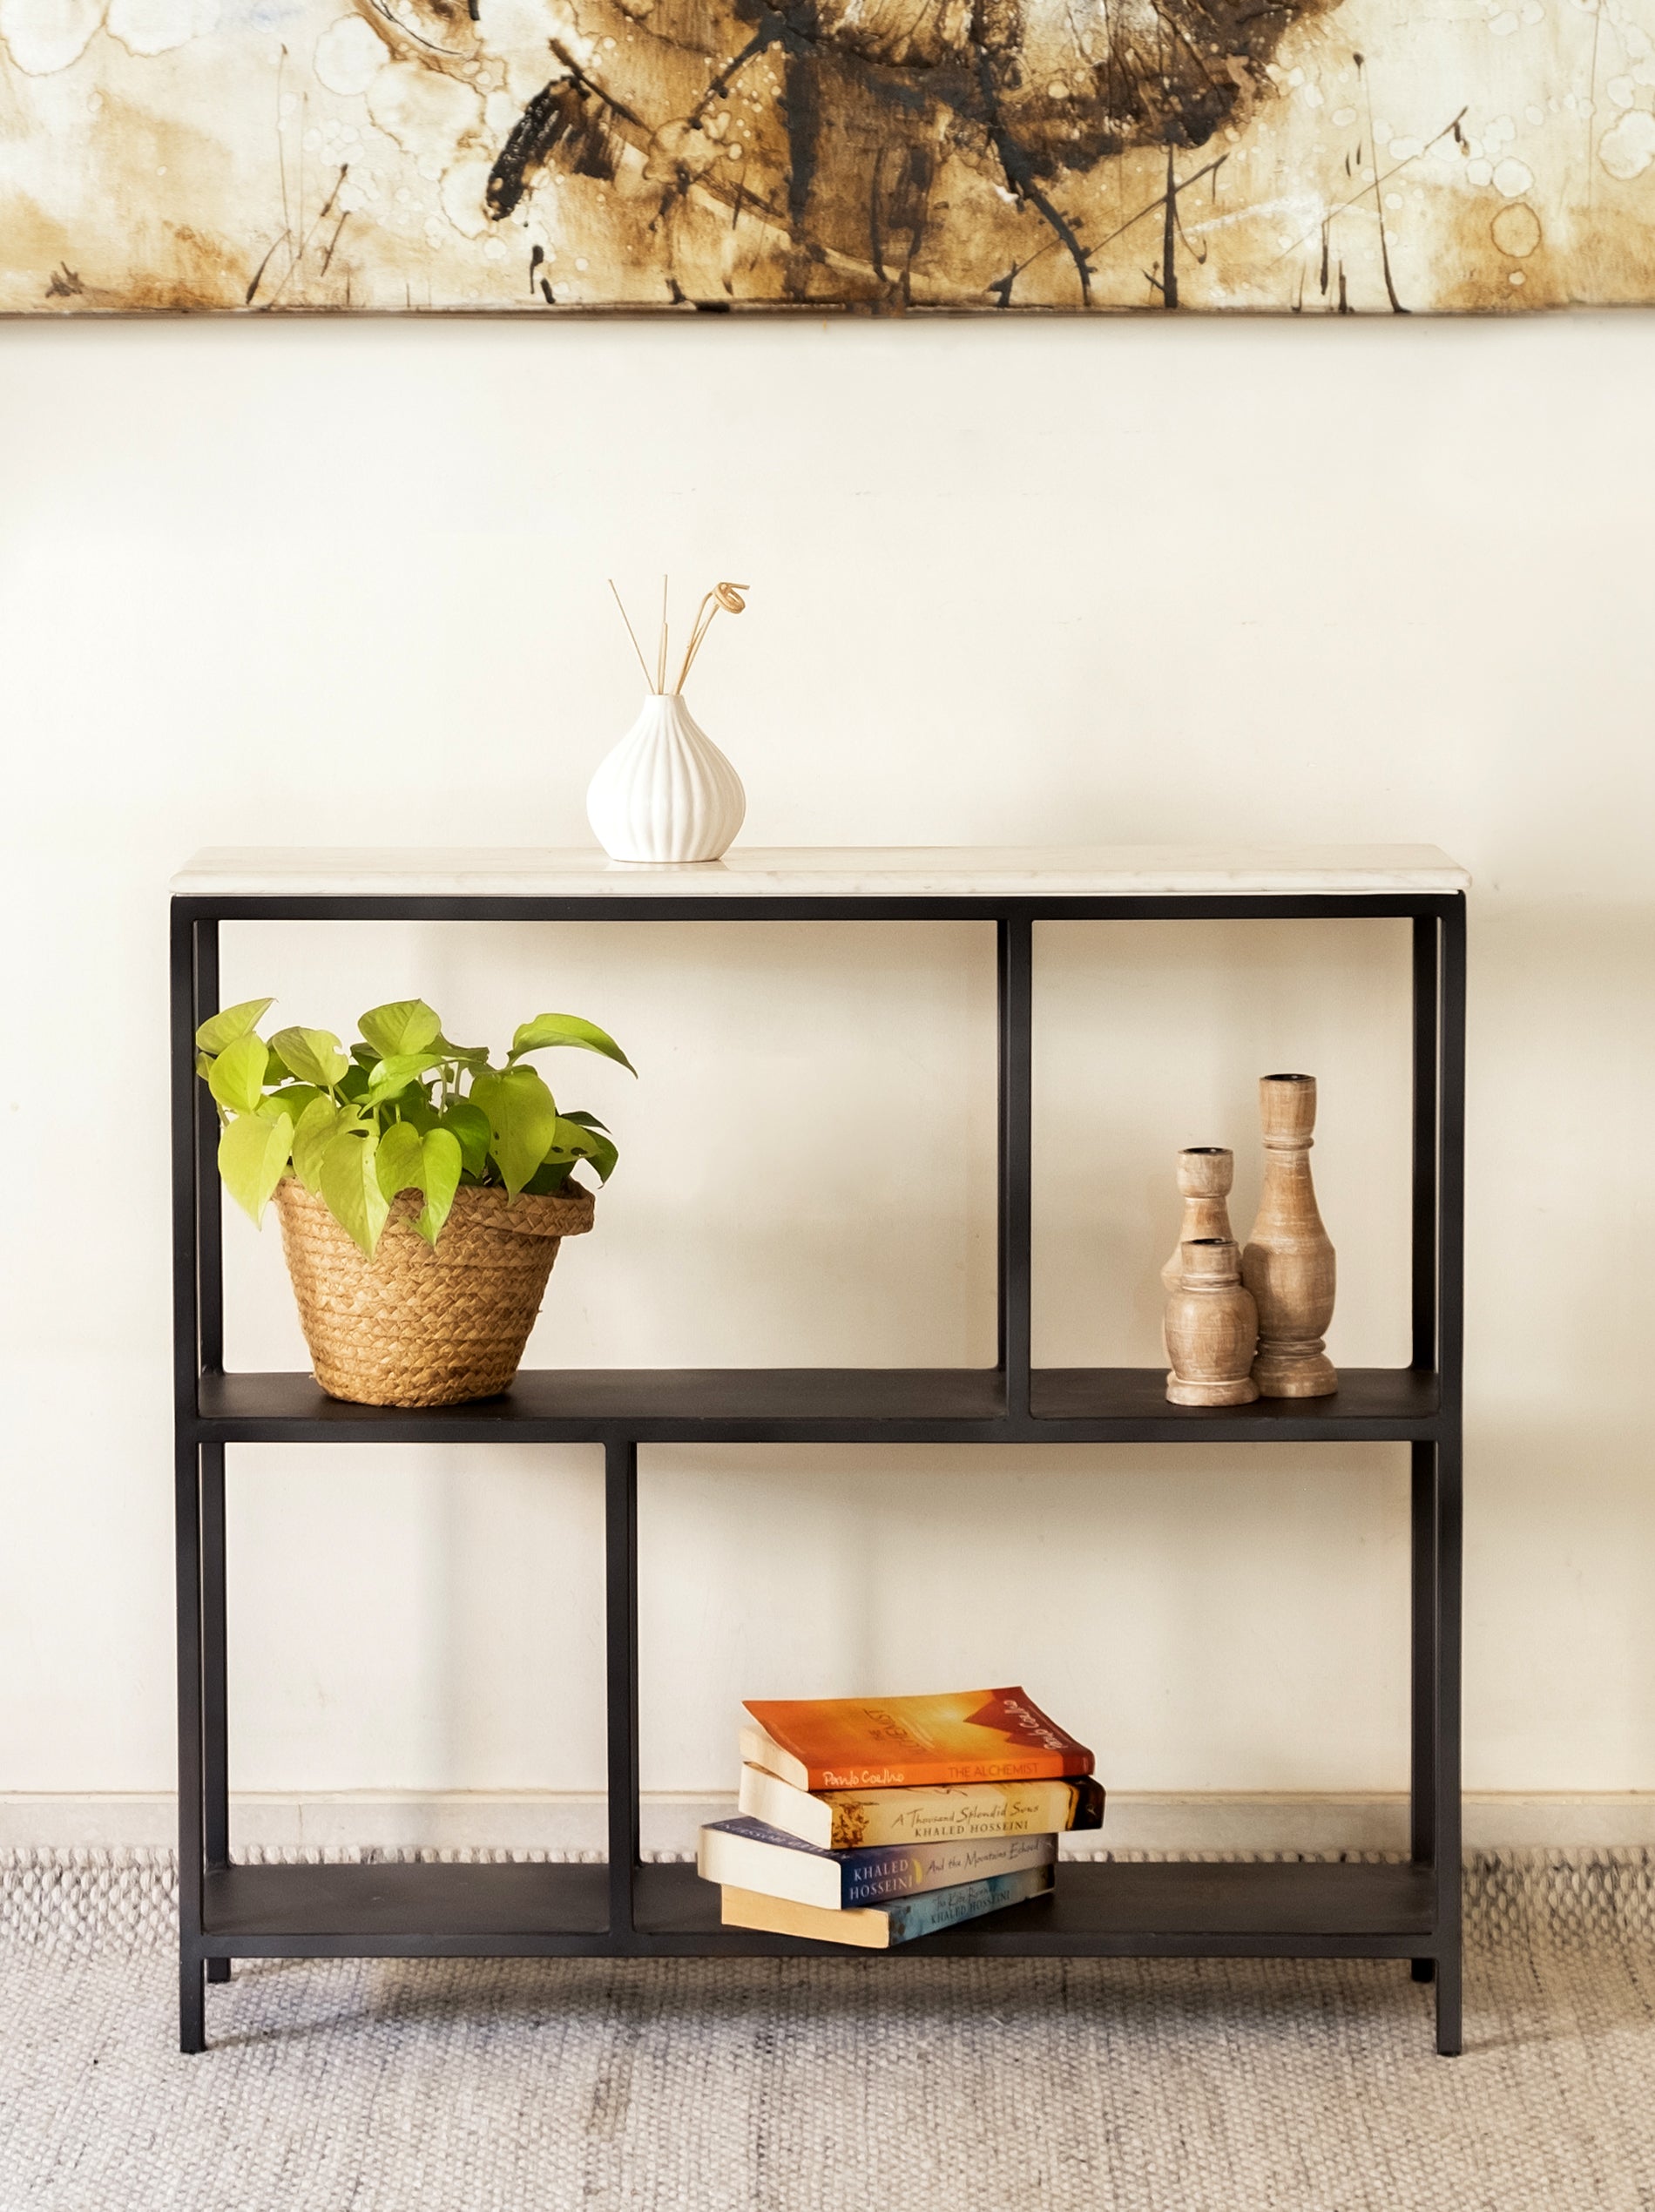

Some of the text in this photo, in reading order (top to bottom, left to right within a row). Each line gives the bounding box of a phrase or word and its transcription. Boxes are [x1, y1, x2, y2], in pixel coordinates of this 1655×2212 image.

[822, 1768, 905, 1786] Paulo Coelho
[948, 1762, 1039, 1778] THE ALCHEMIST
[891, 1802, 1039, 1828] A Thousand Splendid Suns
[915, 1821, 1028, 1837] KHALED HOSSEINI
[927, 1840, 1039, 1874] And the Mountains Echoed
[854, 1859, 909, 1882] KHALED
[849, 1875, 913, 1900] HOSSEINI
[931, 1890, 1010, 1925] KHALED HOSSEINI
